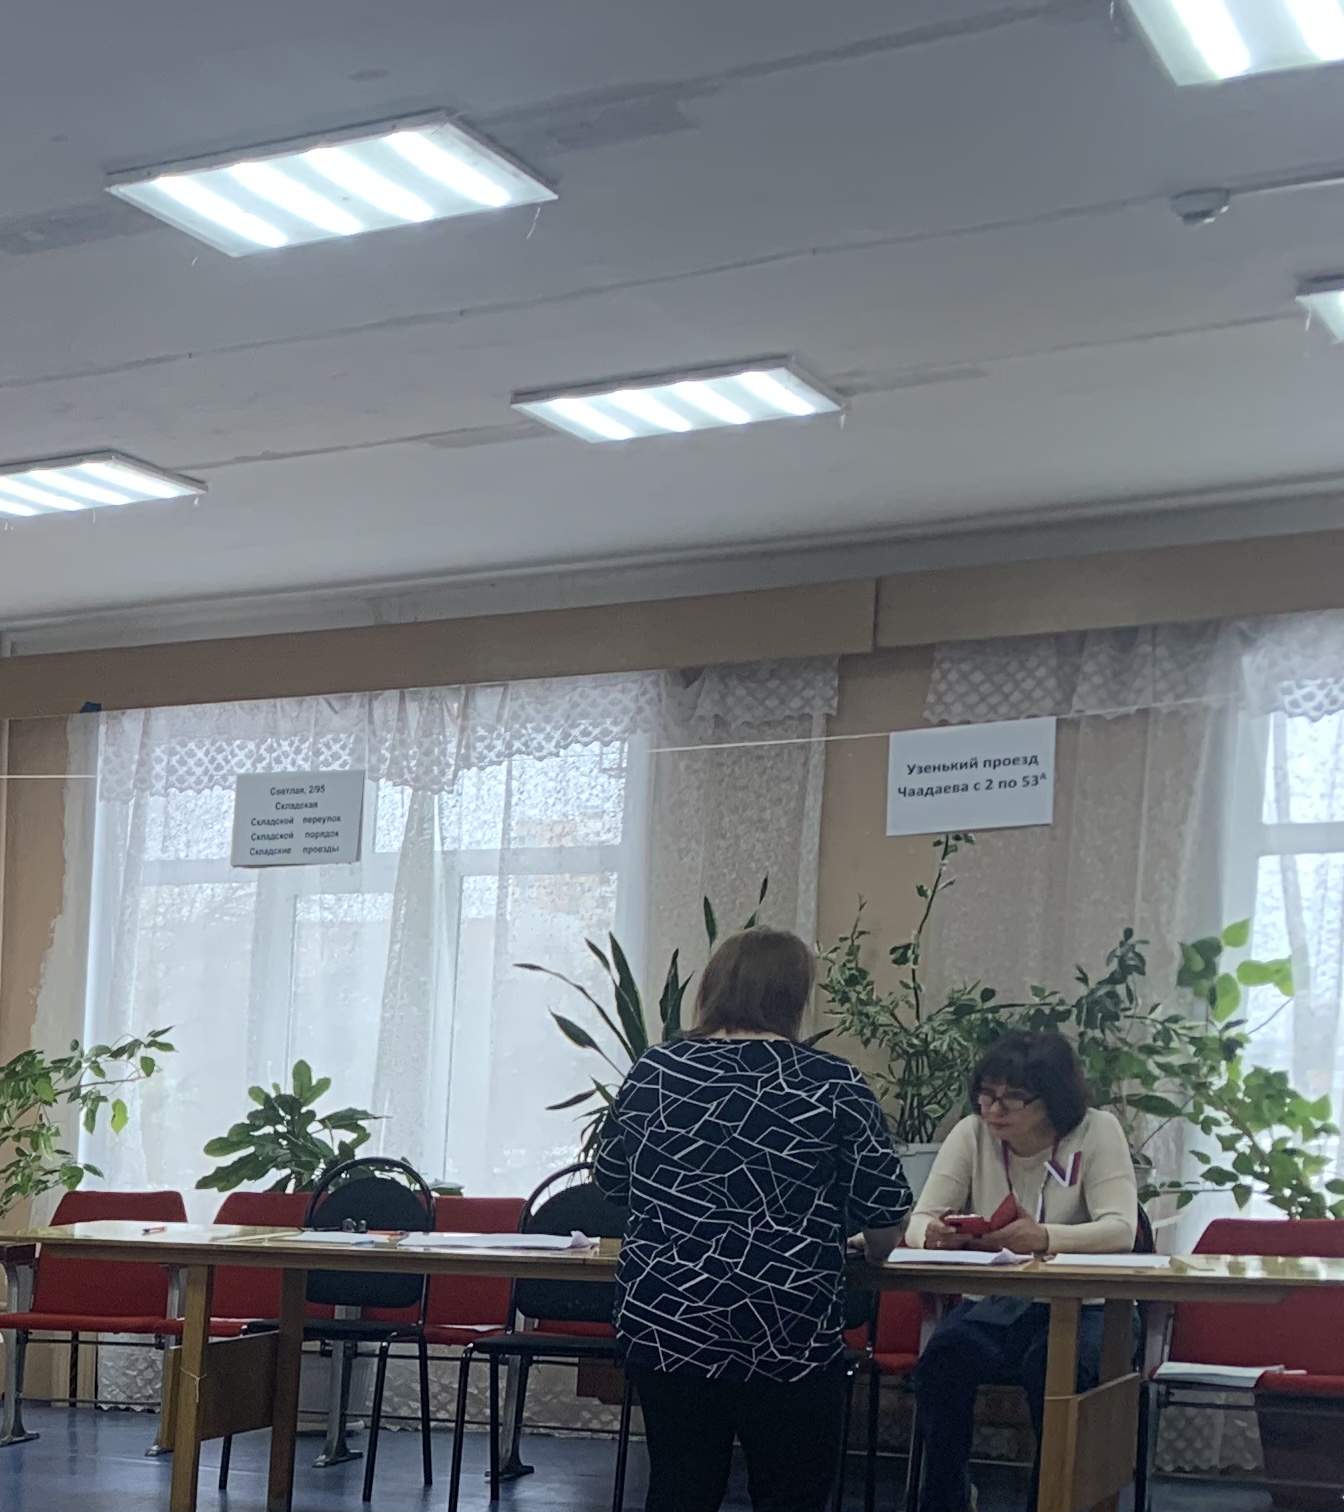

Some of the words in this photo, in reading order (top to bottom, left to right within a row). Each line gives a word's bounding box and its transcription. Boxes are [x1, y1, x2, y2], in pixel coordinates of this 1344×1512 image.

[906, 757, 978, 775] Узенький
[983, 754, 1039, 770] проезд
[309, 784, 325, 794] 2/95
[898, 782, 968, 798] Чаадаева
[973, 782, 981, 792] с
[985, 779, 993, 790] 2
[998, 778, 1017, 789] по
[275, 801, 318, 811] Складская
[251, 815, 294, 826] Складской
[302, 816, 341, 825] переулок
[251, 831, 294, 841] Складской
